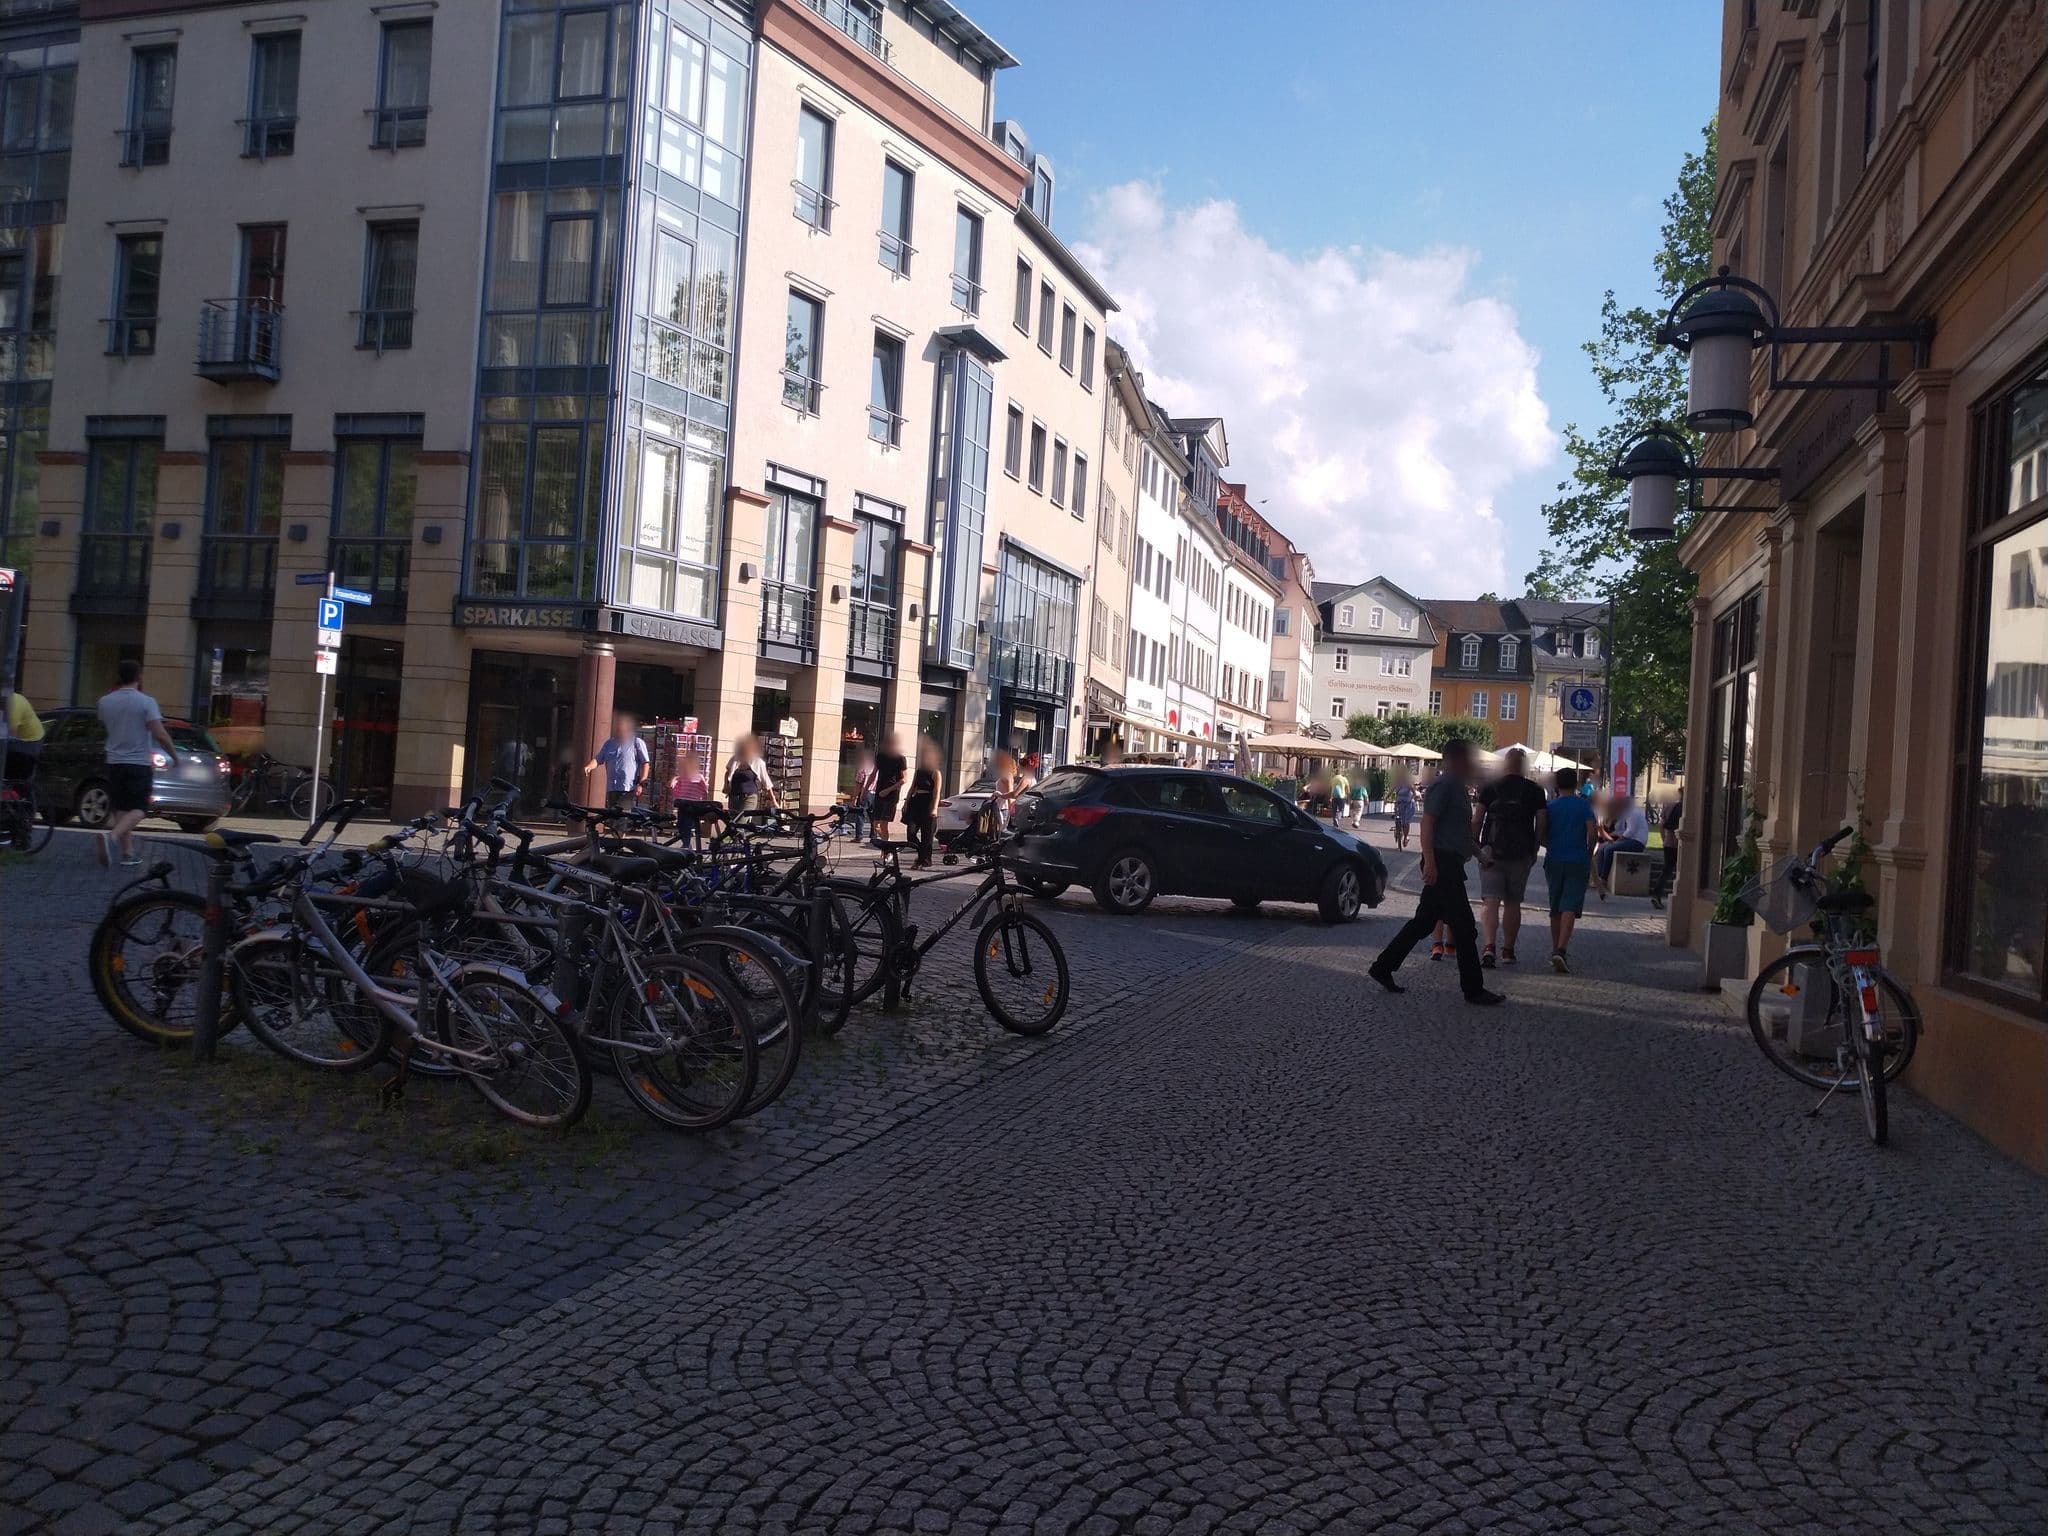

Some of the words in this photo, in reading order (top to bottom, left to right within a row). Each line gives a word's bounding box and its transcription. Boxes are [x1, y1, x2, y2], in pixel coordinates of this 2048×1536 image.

[323, 602, 338, 625] P
[463, 606, 574, 628] SPARKASSE
[630, 617, 716, 647] SPARKASSE
